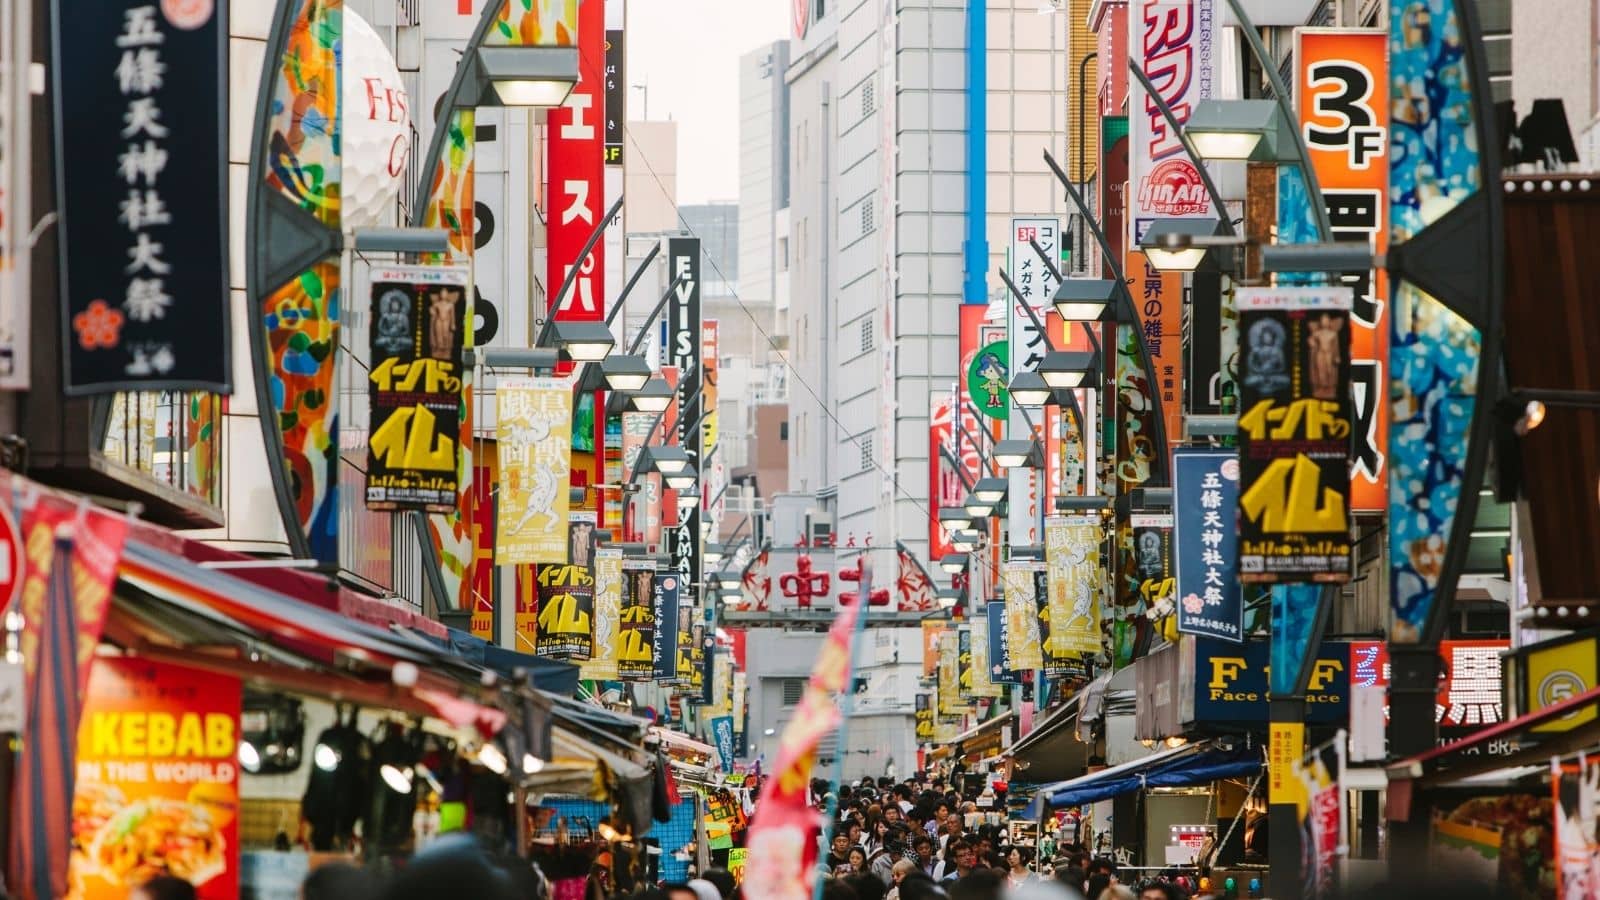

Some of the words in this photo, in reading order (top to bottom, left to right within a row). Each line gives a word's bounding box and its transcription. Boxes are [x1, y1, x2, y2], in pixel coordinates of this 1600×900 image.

[1304, 59, 1386, 169] 3F
[1018, 227, 1036, 242] 3F
[1021, 258, 1032, 298] メガネ
[369, 356, 461, 393] インドの
[370, 402, 456, 471] 仏
[1239, 398, 1350, 441] インドの
[1240, 452, 1348, 533] 仏
[1201, 472, 1225, 605] 五條天神社大祭
[1210, 689, 1258, 702] Face
[1305, 693, 1341, 703] ace
[92, 711, 235, 758] KEBAB
[106, 761, 147, 782] THE
[152, 762, 235, 783] WORLD
